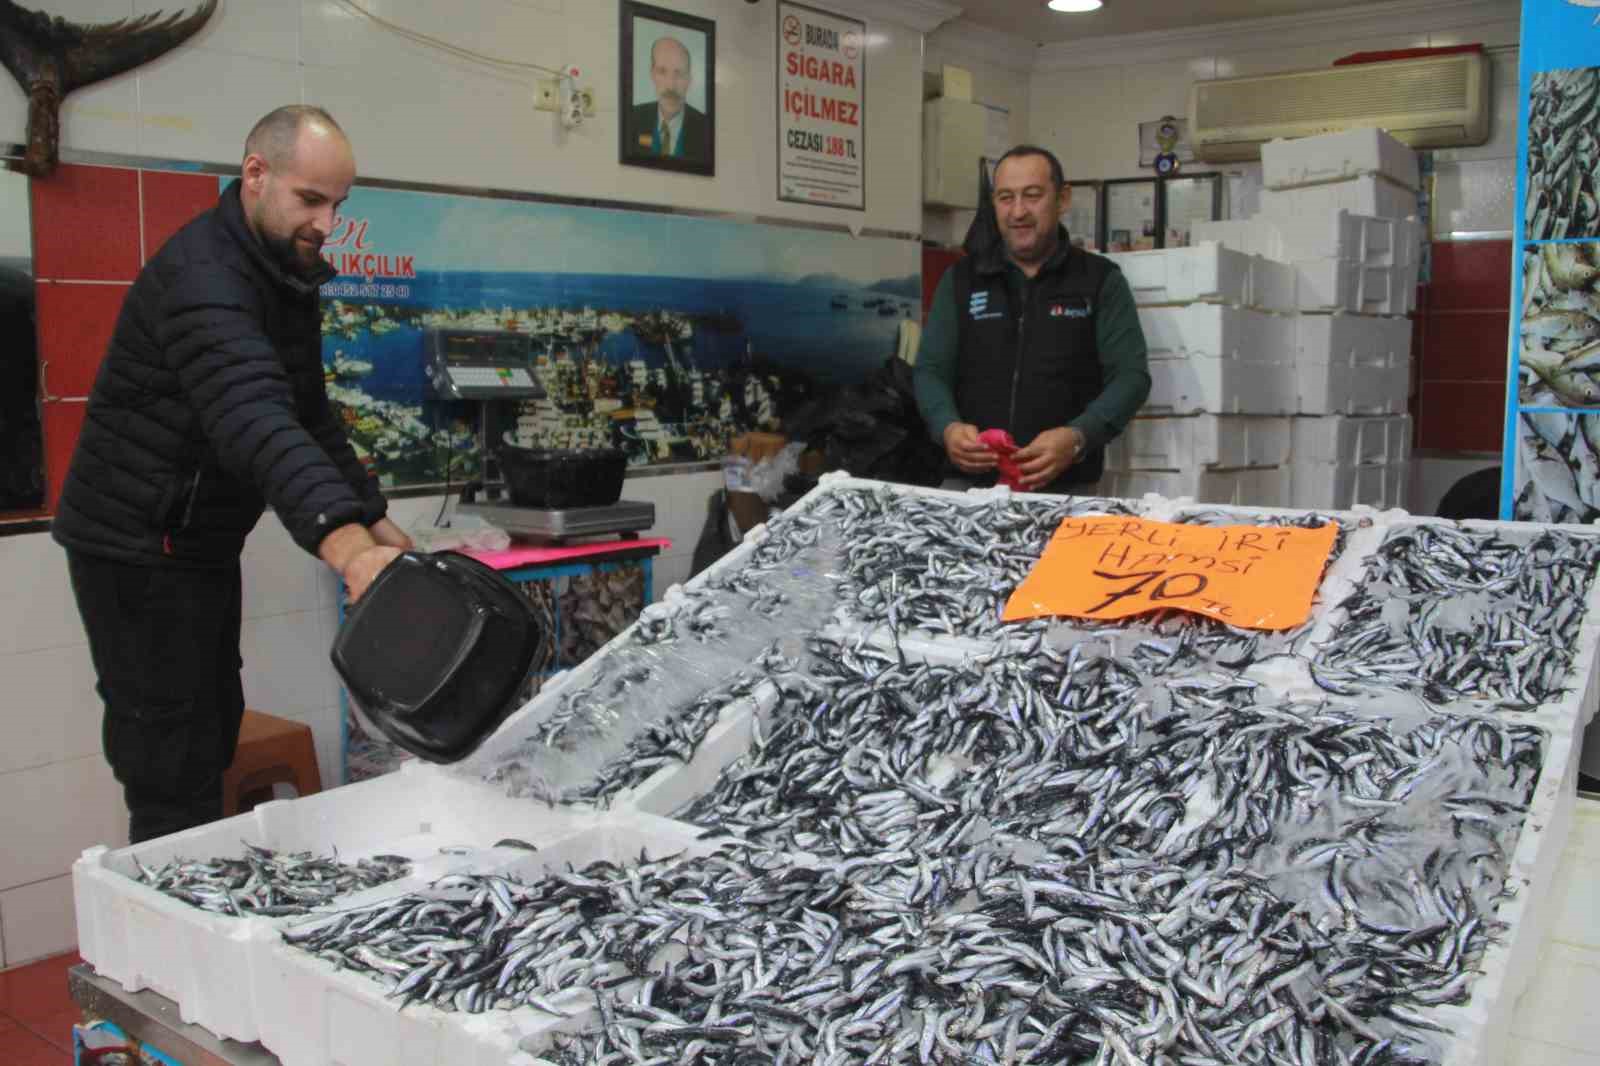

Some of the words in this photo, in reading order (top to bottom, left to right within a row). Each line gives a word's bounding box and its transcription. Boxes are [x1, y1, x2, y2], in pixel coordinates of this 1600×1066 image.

[805, 23, 840, 51] BURADA
[785, 48, 856, 89] SİGARA
[783, 82, 859, 127] İÇİLMEZ
[787, 128, 823, 152] CEZASI
[846, 139, 857, 159] TL
[1084, 568, 1209, 614] 70
